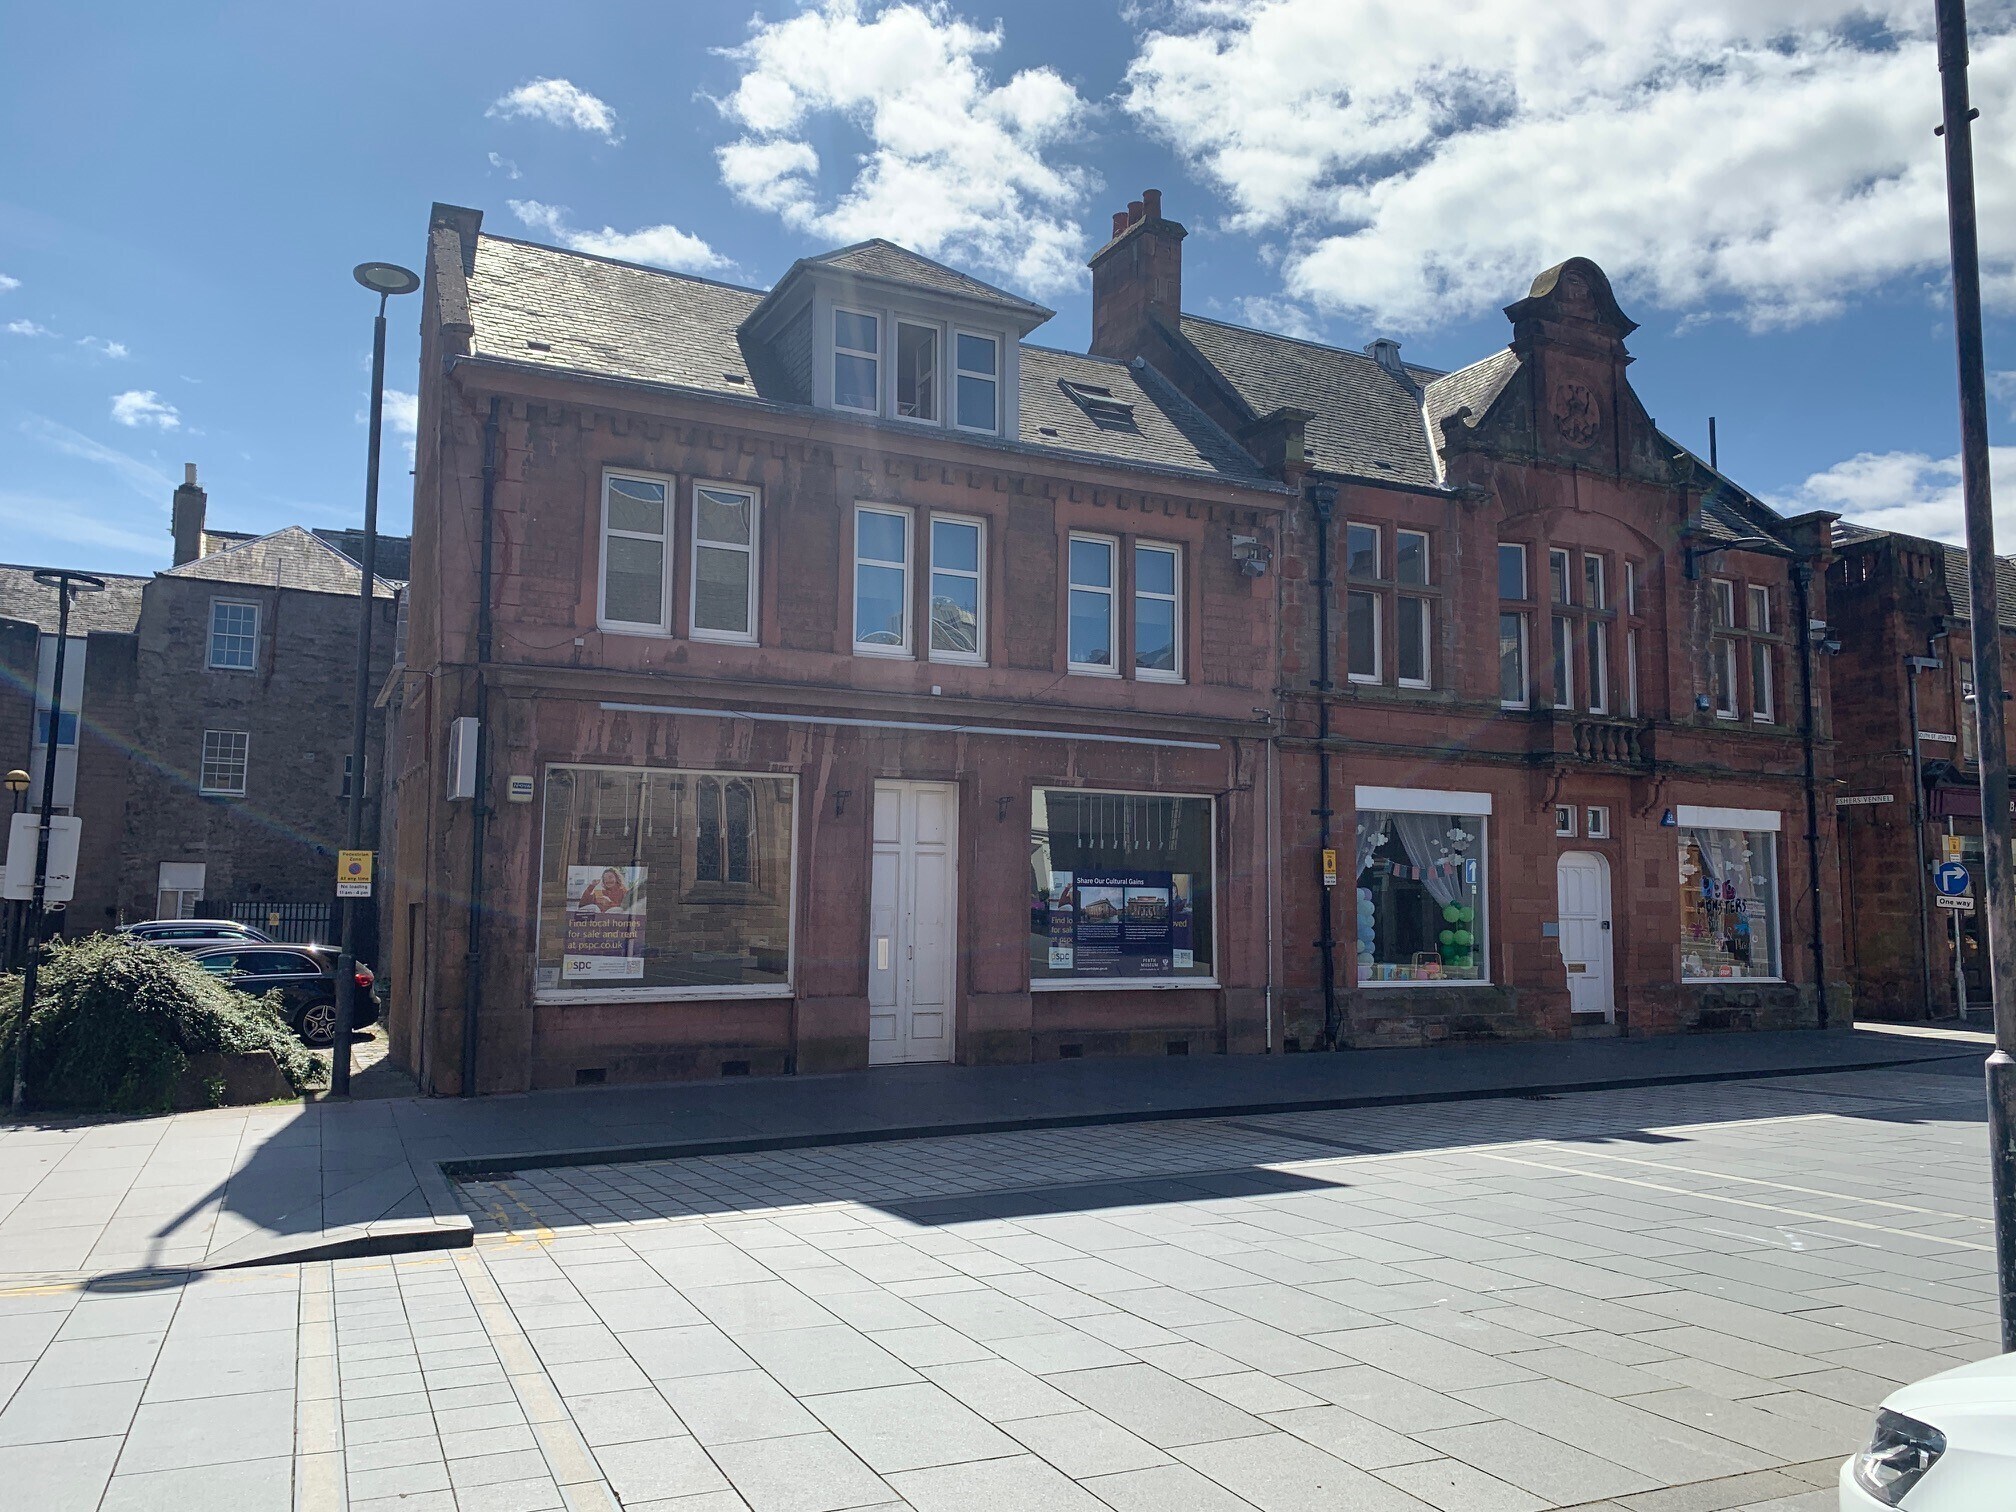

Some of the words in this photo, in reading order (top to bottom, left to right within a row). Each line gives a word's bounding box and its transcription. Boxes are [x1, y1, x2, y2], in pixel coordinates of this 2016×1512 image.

[568, 919, 587, 927] Find
[589, 919, 610, 927] local
[612, 919, 640, 928] homes
[1051, 916, 1066, 924] Find
[1051, 925, 1061, 933] for
[568, 930, 580, 938] for
[583, 930, 600, 938] sale
[602, 930, 619, 938] and
[620, 930, 638, 938] rent
[567, 941, 576, 949] at
[578, 941, 623, 951] pspc.co.uk
[1051, 952, 1070, 962] pspc
[566, 960, 592, 972] pspc
